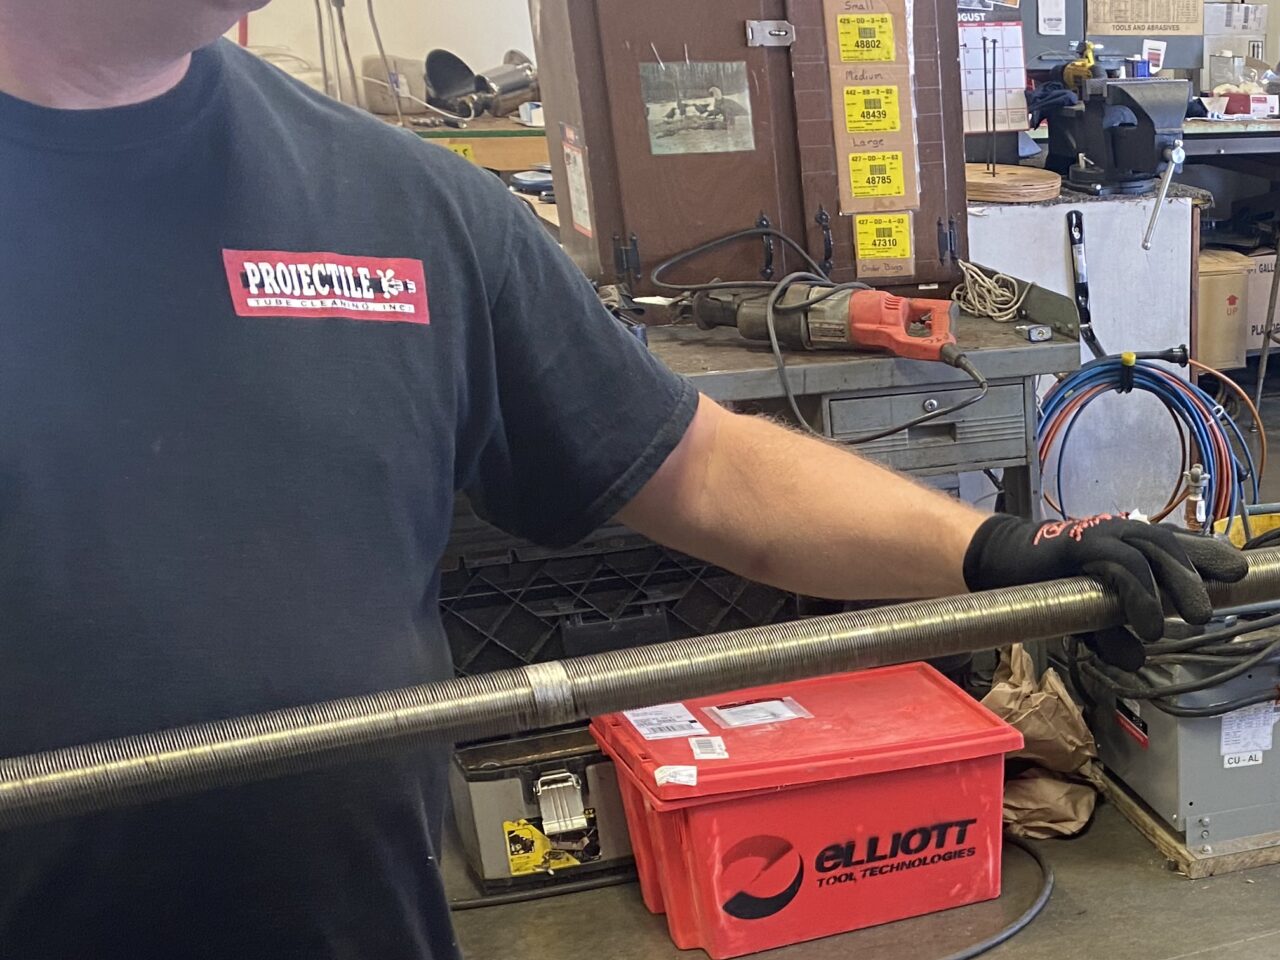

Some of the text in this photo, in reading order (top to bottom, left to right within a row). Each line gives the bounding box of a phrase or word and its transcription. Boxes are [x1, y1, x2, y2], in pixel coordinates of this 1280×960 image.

[844, 0, 874, 10] Small
[854, 39, 881, 48] 48802
[845, 69, 883, 80] Medium
[860, 110, 887, 119] 48439
[852, 137, 885, 148] Large
[865, 175, 892, 185] 48785
[871, 238, 897, 247] 47310
[243, 262, 375, 299] PROJECTILE
[1226, 307, 1238, 316] UP
[1251, 322, 1280, 336] PLAIC
[1227, 757, 1240, 765] CU
[1247, 754, 1260, 763] AL
[816, 846, 976, 888] TOOL TECHNOLOGIES
